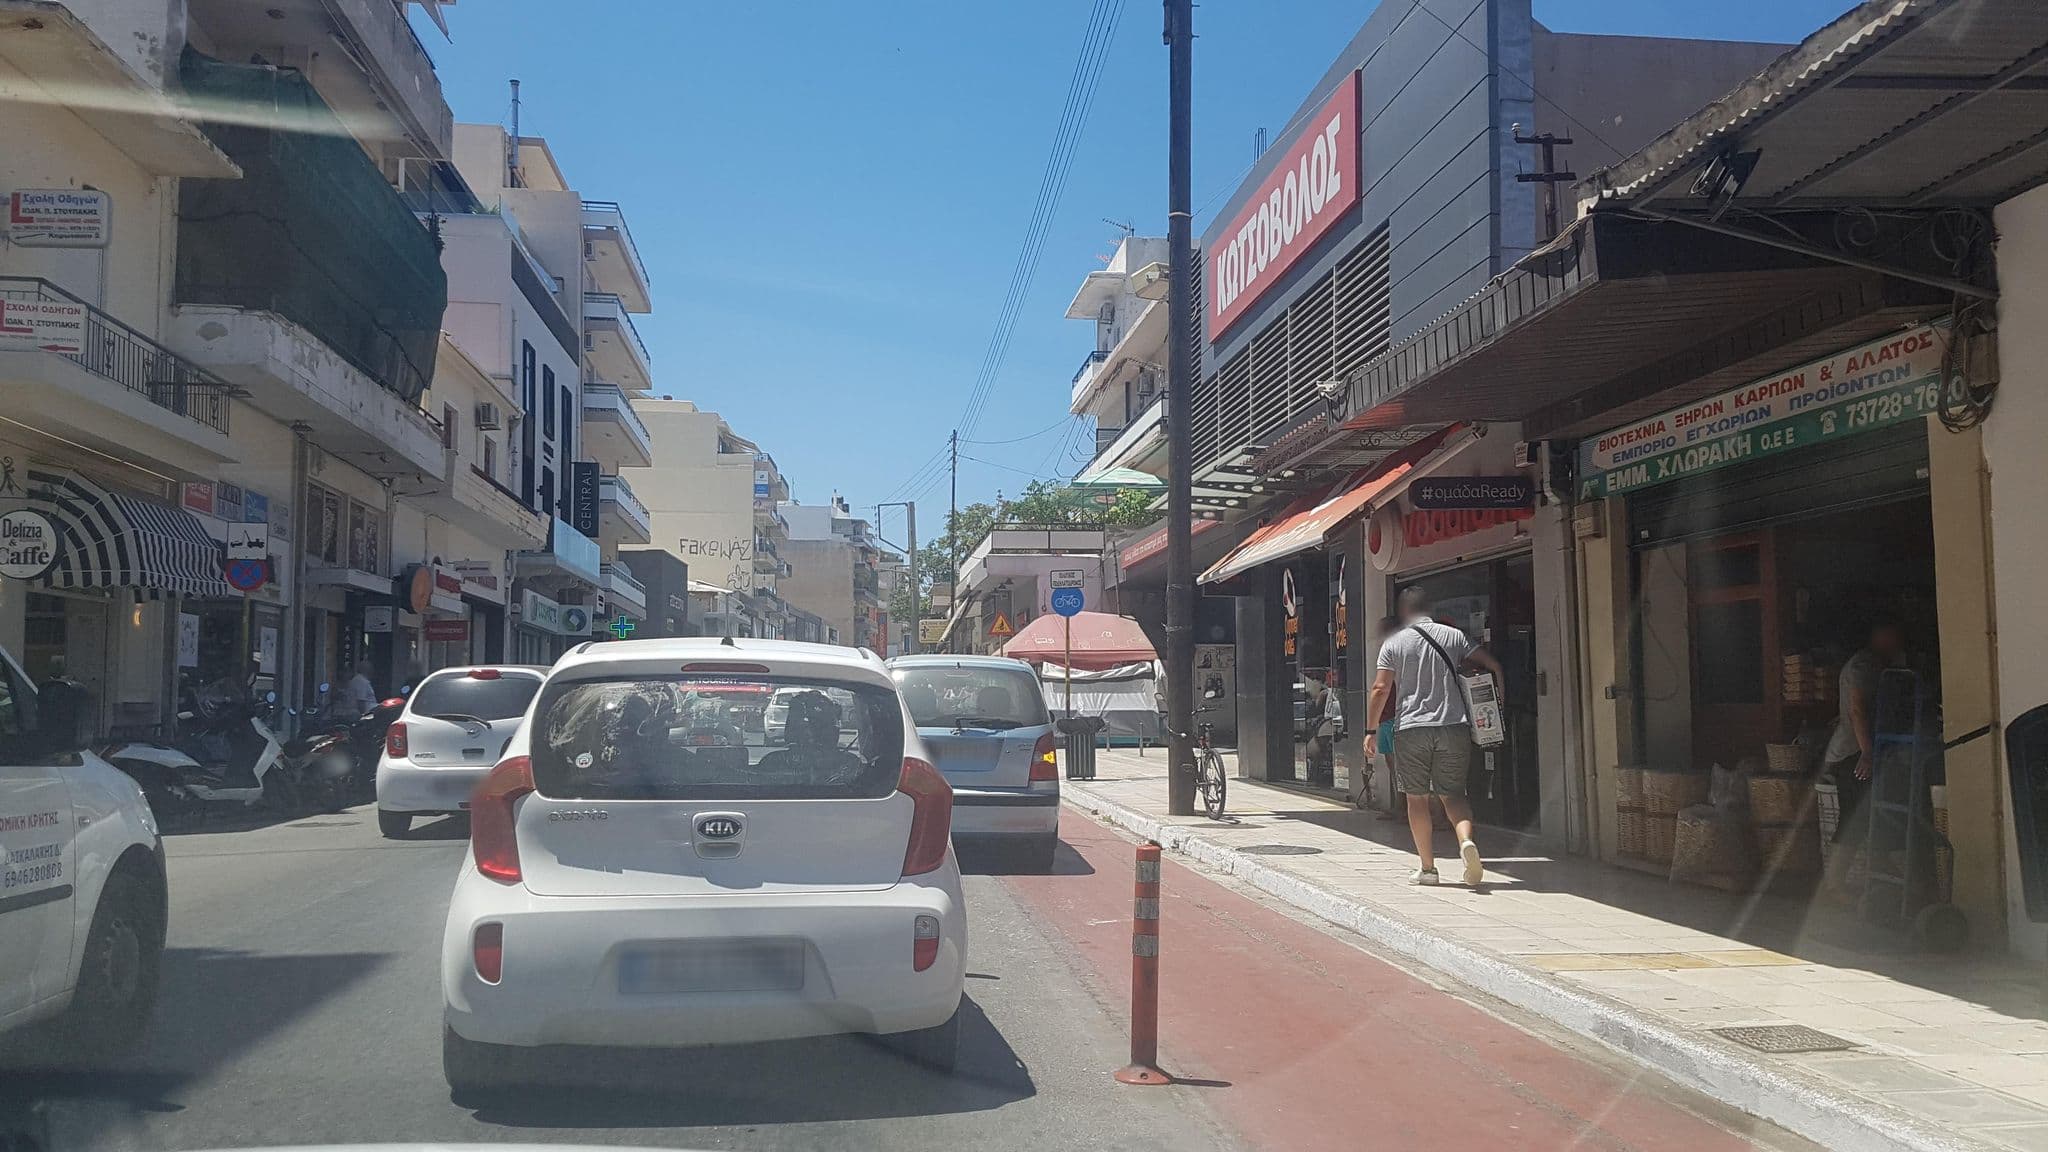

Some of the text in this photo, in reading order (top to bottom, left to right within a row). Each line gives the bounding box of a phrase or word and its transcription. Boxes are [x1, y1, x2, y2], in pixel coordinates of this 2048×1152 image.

[1216, 112, 1341, 316] ΚΩΤΣΟΒΟΛΟΣ
[6, 303, 80, 315] ΣΧΟΛΗ ΟΔΗΓΩΝ
[36, 320, 80, 329] ΣΤΟΥΠΑΚΗΣ
[1599, 421, 1667, 453] ΒΙΟΤΕΧΝΙΑ
[1675, 400, 1724, 428] ΞΗΡΩΝ
[1734, 373, 1805, 409] ΚΑΡΠΩΝ
[1846, 329, 1933, 374] ΑΛΑΤΟΣ
[1612, 435, 1677, 464] ΕΜΠΟΡΙΟ
[1686, 404, 1772, 443] ΕΓΧΩΡΙΩΝ
[1605, 464, 1651, 493] ΕΜΜ.
[1657, 434, 1752, 480] ΧΛΩΡΑΚΗ
[581, 469, 592, 530] CENTRAL
[1422, 484, 1526, 502] #ομάδαReady
[3, 518, 42, 538] Delizia
[9, 539, 17, 547] &
[28, 811, 59, 829] ΚΡΗΤΗΣ
[705, 821, 734, 834] KIA
[5, 862, 63, 888] 6946280808
